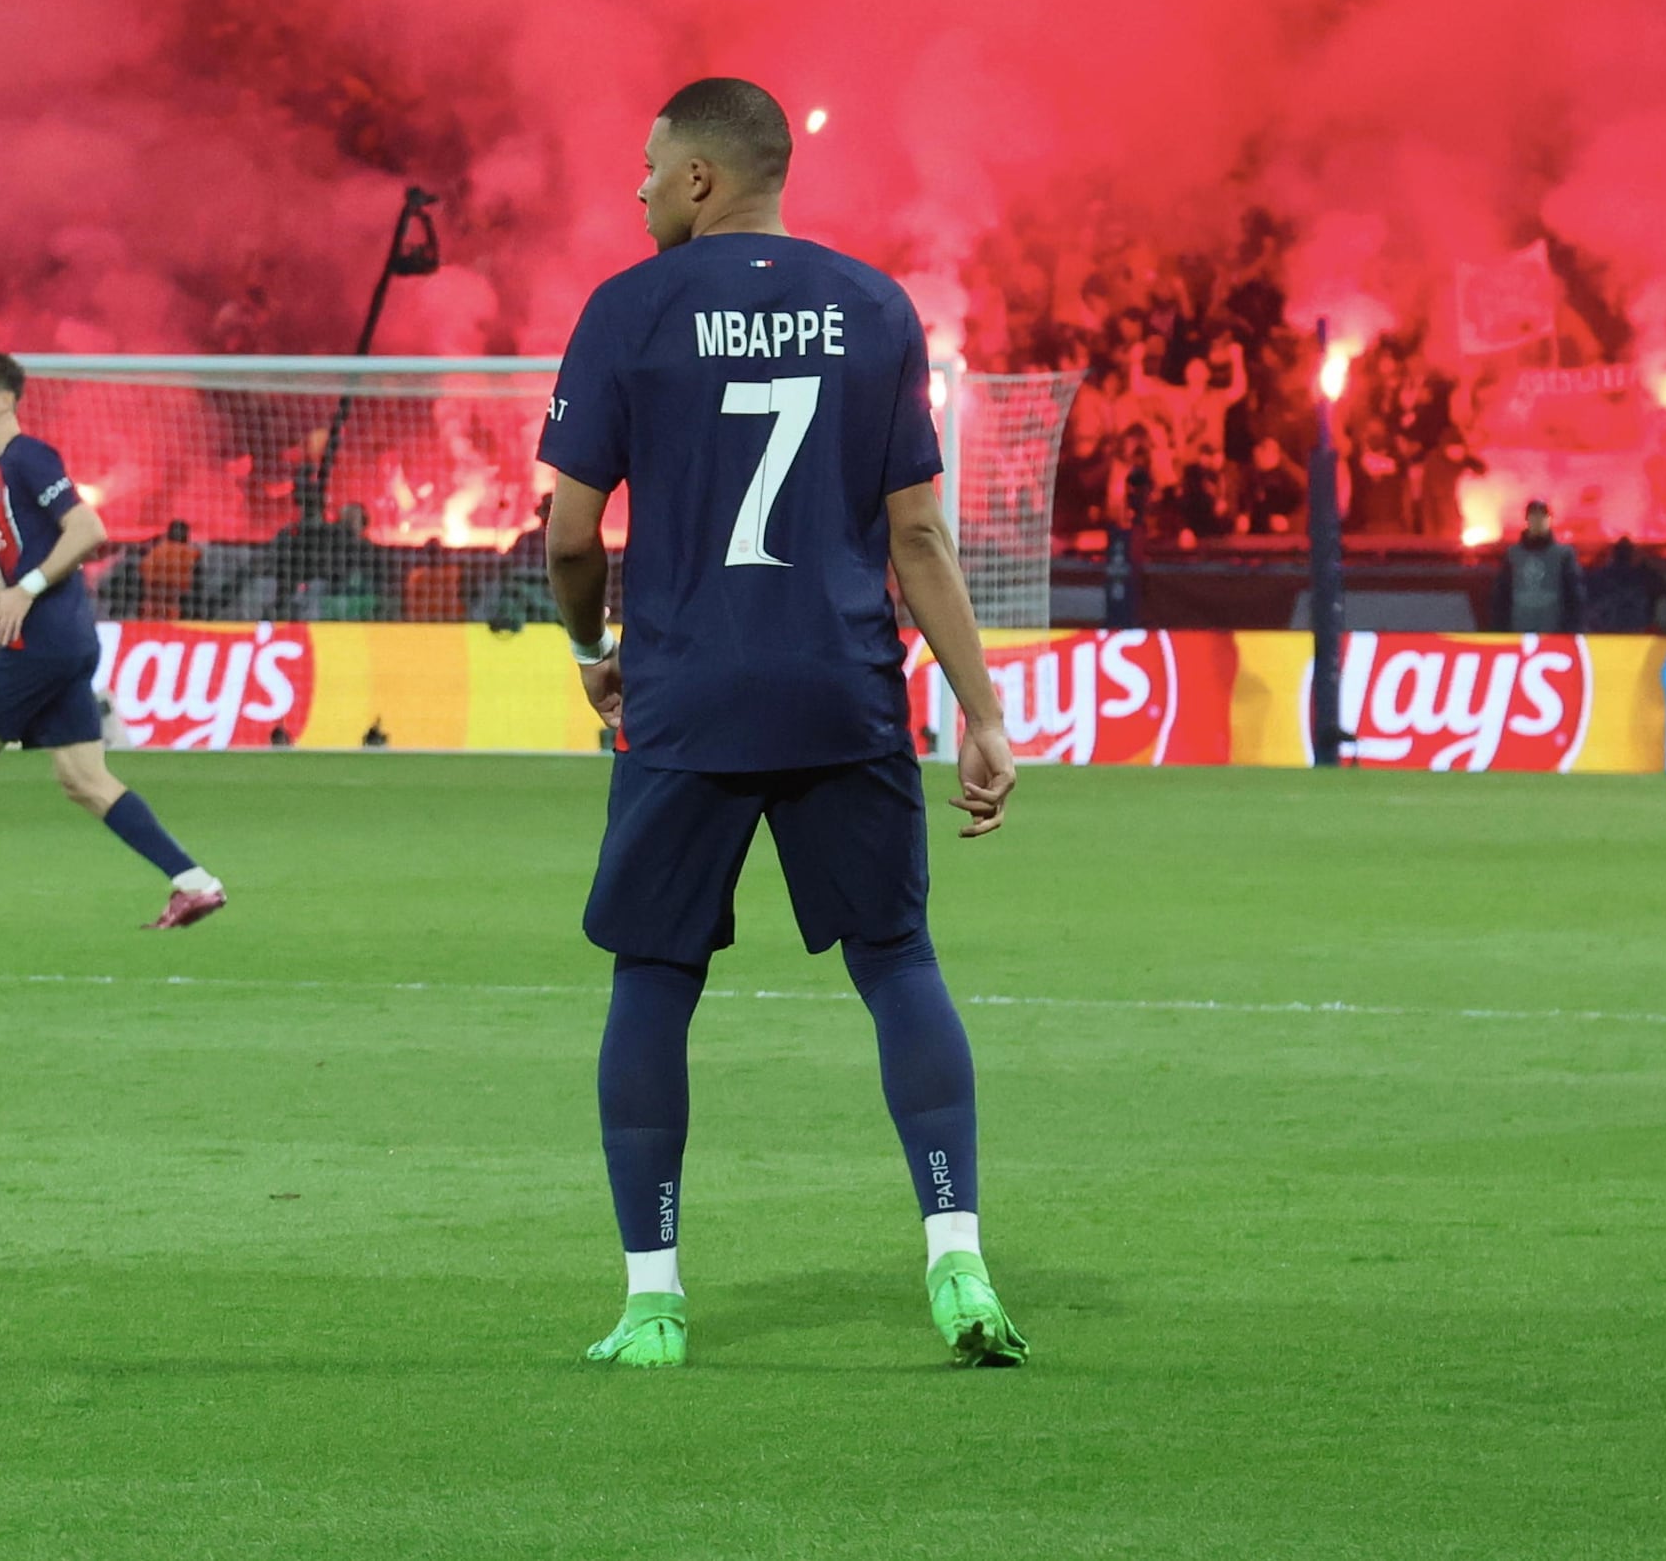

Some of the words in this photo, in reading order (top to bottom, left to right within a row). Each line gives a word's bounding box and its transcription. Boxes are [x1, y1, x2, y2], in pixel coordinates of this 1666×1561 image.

[694, 304, 845, 357] MBAPPÉ
[721, 376, 822, 567] 7
[1338, 631, 1573, 772] Lay's
[929, 1149, 956, 1209] PARIS
[659, 1181, 674, 1243] PARIS
